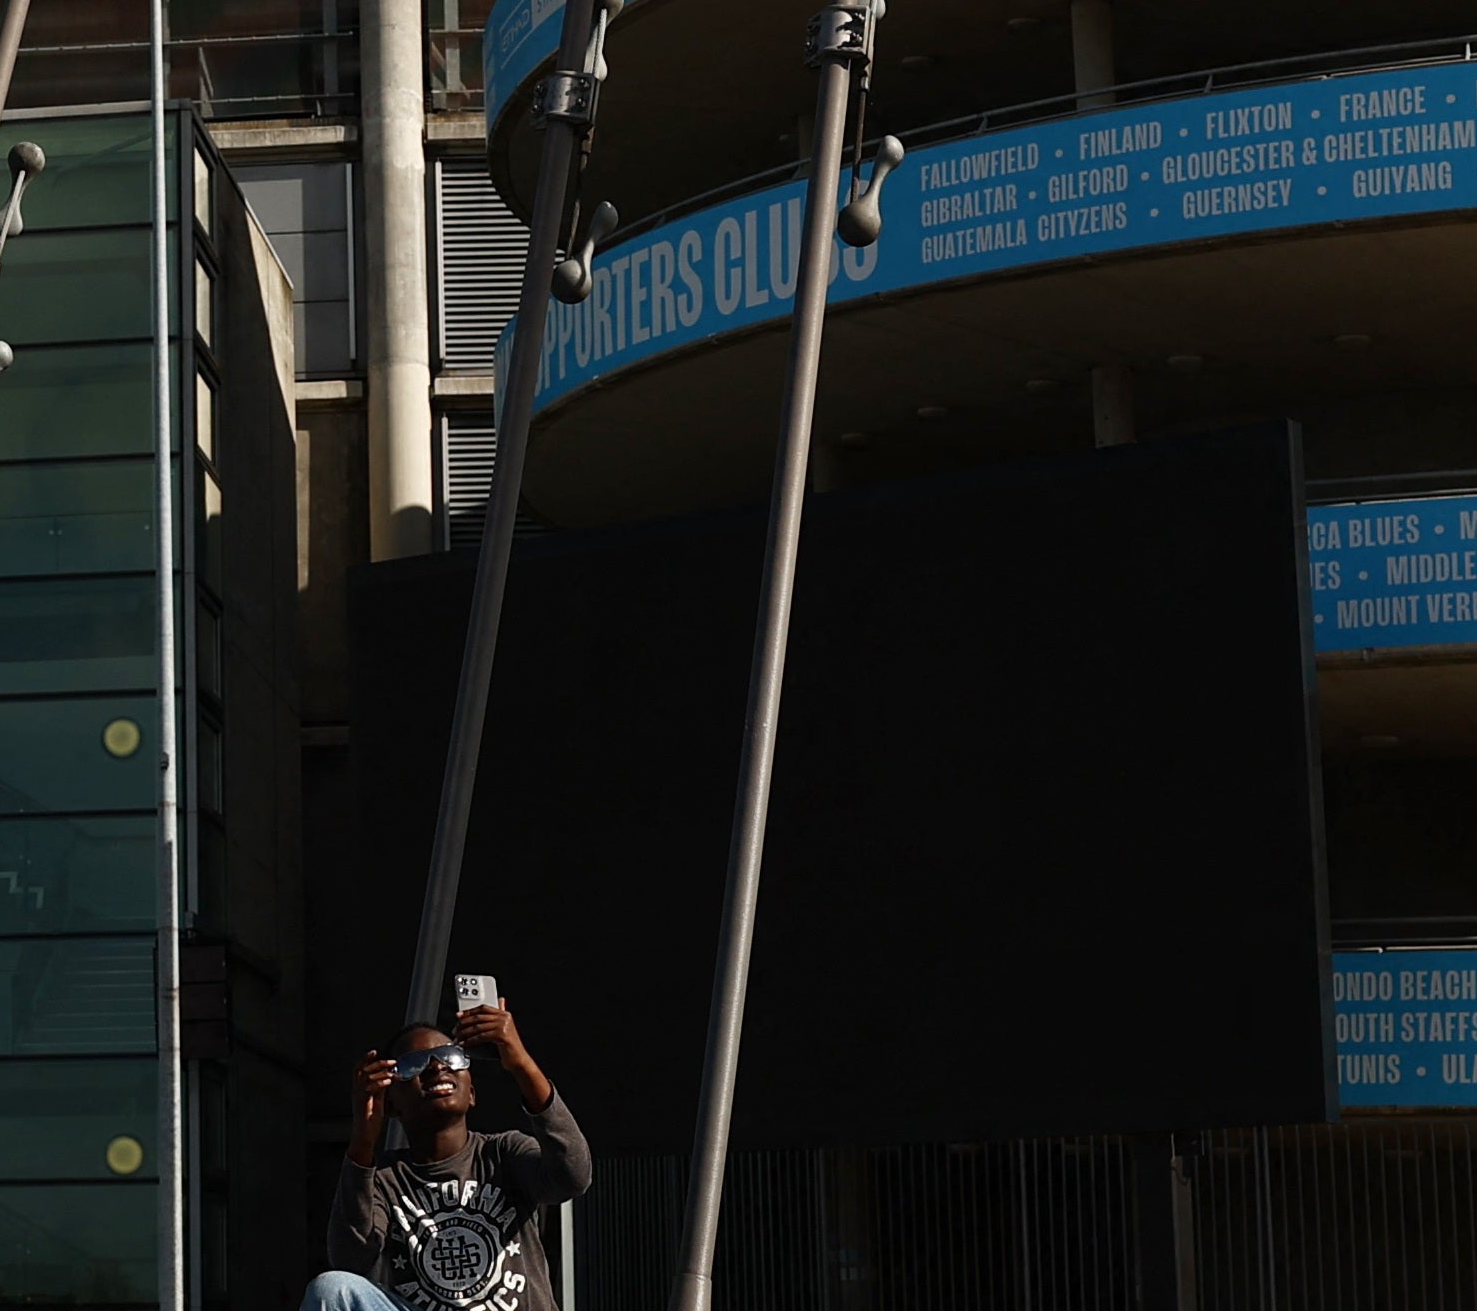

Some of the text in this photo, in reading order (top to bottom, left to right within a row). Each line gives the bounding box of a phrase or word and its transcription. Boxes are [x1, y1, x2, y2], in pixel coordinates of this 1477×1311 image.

[1324, 120, 1476, 162] CHELTENHAM
[1337, 595, 1420, 629] MOUNT
[1400, 970, 1476, 1000] BEACH
